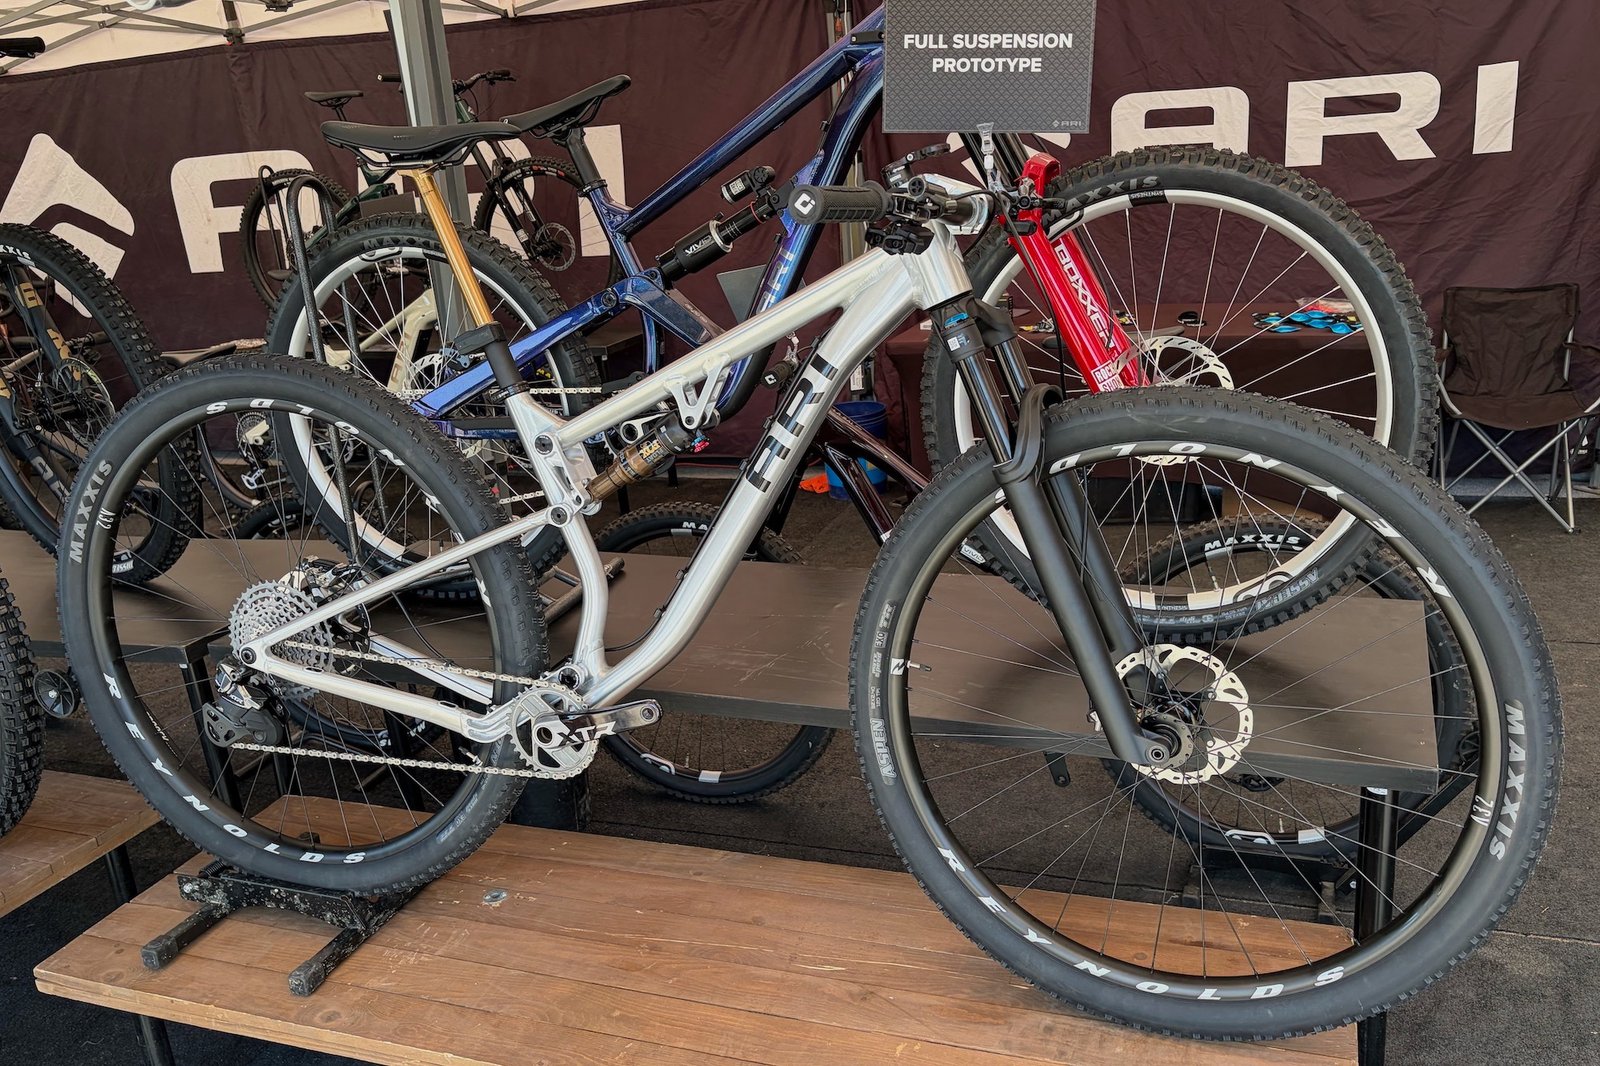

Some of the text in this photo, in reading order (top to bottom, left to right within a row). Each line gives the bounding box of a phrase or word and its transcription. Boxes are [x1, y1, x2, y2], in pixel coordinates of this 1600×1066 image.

[904, 33, 1073, 49] FULL SUSPENSION
[932, 58, 1042, 72] PROTOTYPE
[1042, 176, 1158, 228] MAXXIS
[1054, 243, 1115, 350] BOXXER
[746, 353, 839, 493] ARI
[69, 460, 112, 564] MAXXIS
[1204, 534, 1301, 552] MAXXIS
[875, 631, 886, 648] EXO
[557, 721, 617, 747] XTR
[870, 718, 897, 778] ASPEN
[103, 673, 366, 864] REYNOLDS
[1489, 703, 1526, 861] MAXXIS
[938, 847, 1345, 1002] REYNOLDS
